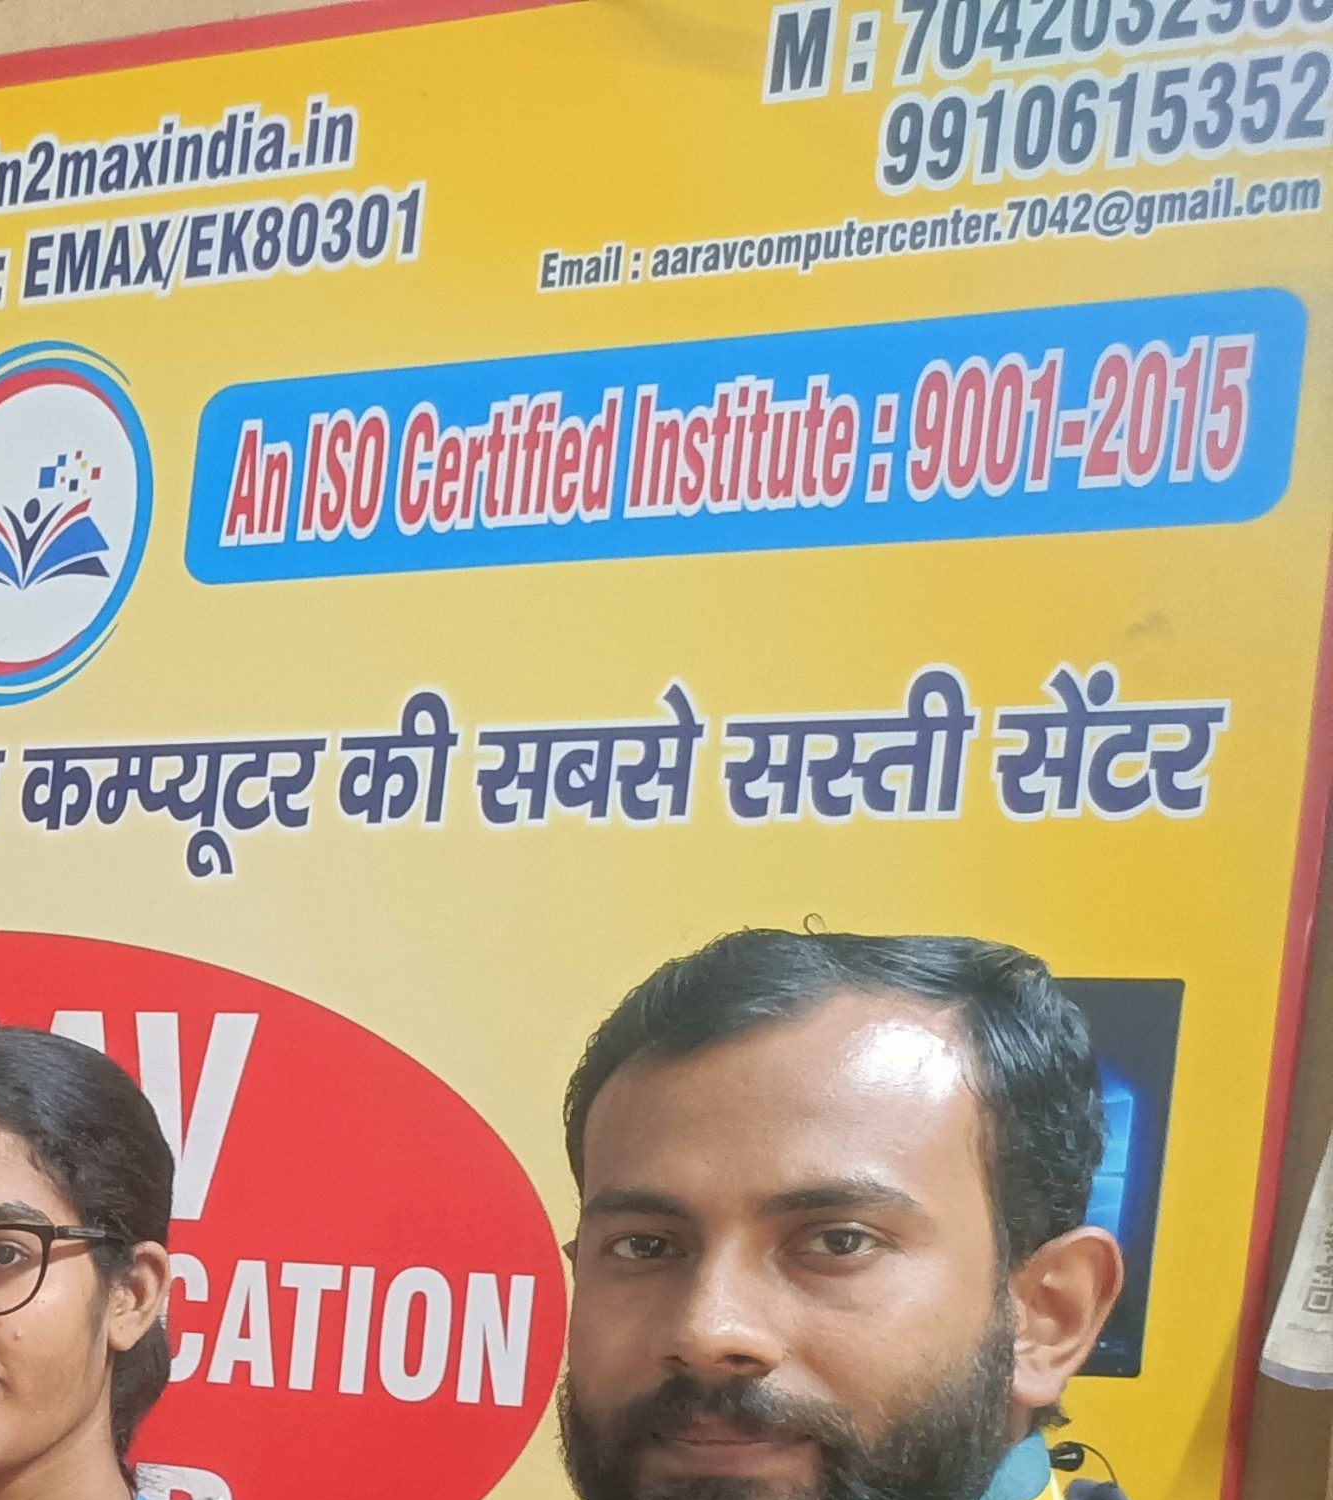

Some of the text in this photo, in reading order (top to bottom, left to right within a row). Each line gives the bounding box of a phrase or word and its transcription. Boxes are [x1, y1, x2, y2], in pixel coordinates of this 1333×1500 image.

[769, 7, 831, 93] M
[884, 50, 1331, 186] 9910615352
[24, 191, 422, 295] EMAX/EK80301
[541, 251, 621, 288] Email
[652, 176, 1320, 276] aaravcomputercenter.7042@gmail.com
[225, 428, 289, 536] An
[302, 417, 384, 531] ISO
[399, 397, 617, 526] Certified
[628, 387, 855, 506] Institute
[911, 342, 1252, 492] 9001-2015
[22, 737, 325, 877] कम्प्यूटर
[339, 692, 457, 824] की
[479, 683, 703, 824] सबसे
[726, 670, 974, 818] सस्ती
[998, 667, 1224, 815] सेंटर
[167, 1252, 535, 1408] CATION
